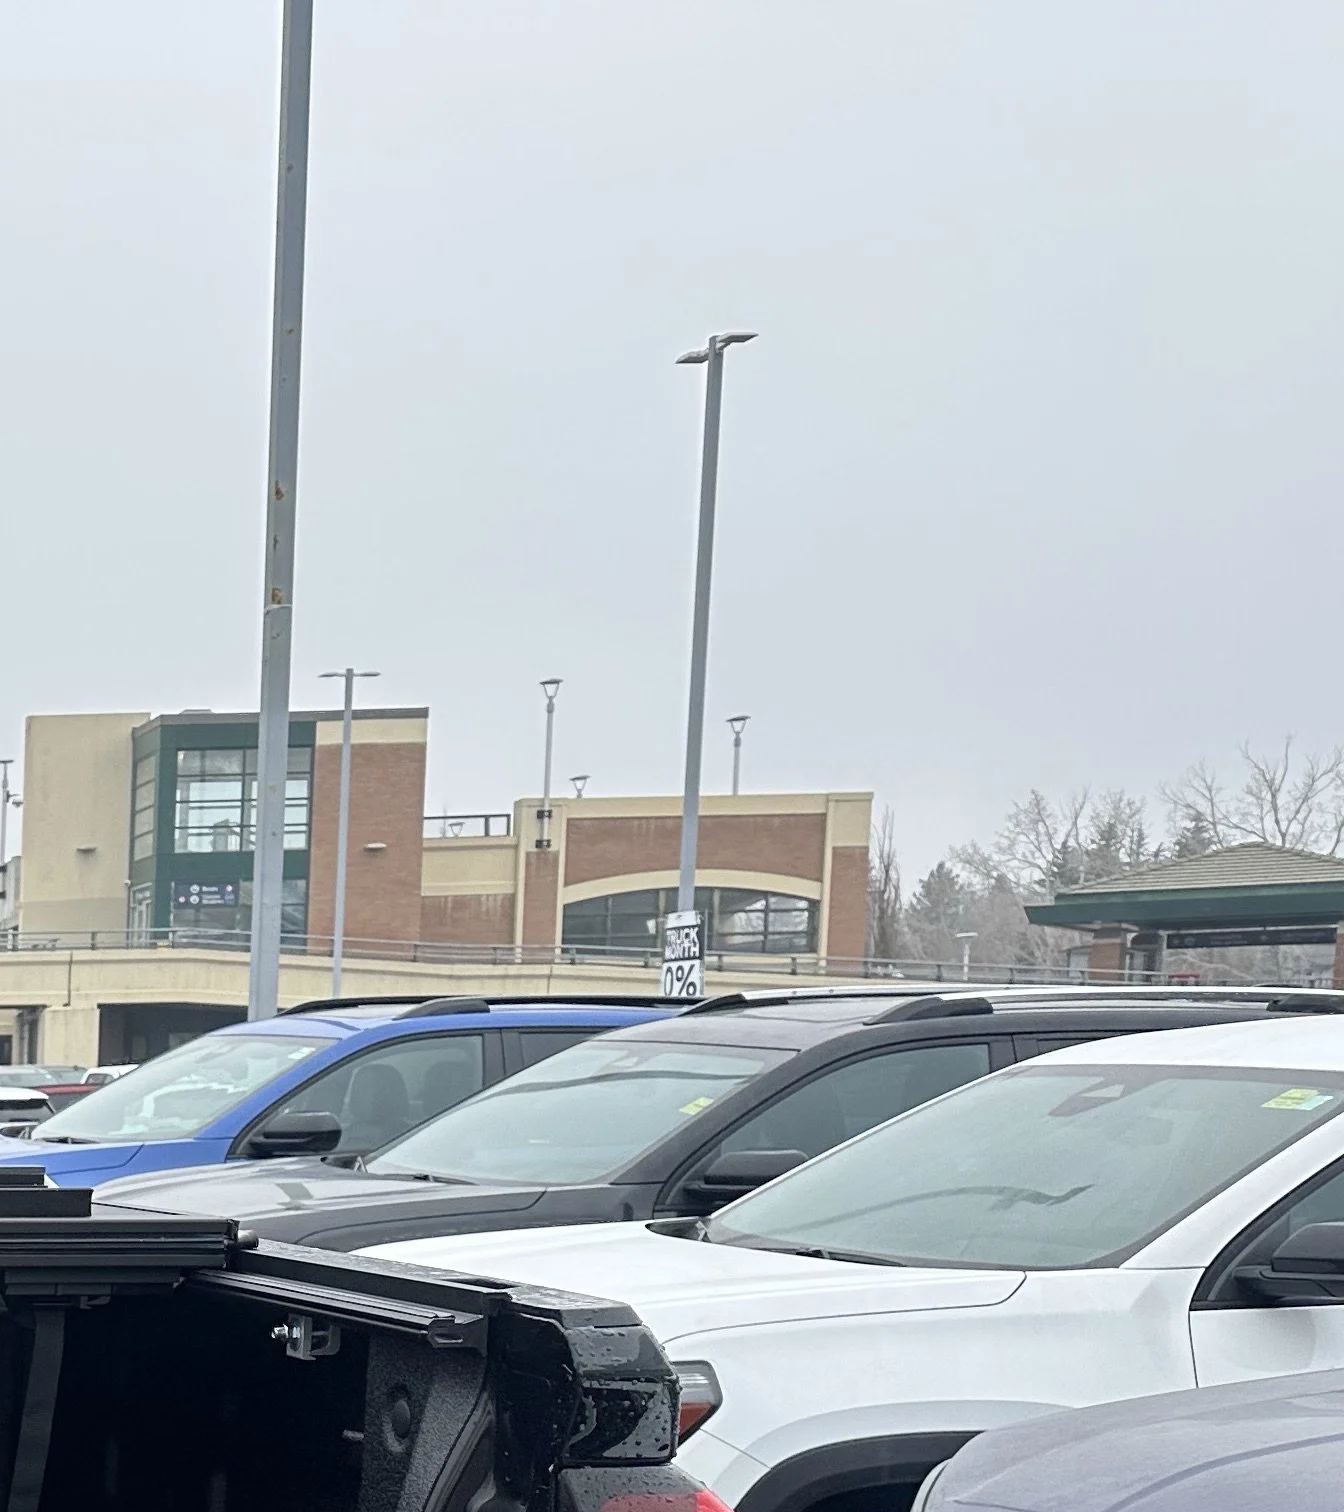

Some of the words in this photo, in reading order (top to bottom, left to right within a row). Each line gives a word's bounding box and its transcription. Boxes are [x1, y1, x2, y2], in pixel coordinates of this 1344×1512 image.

[666, 927, 699, 943] TRUCK
[665, 942, 700, 959] MONTH
[664, 964, 697, 996] 0%
